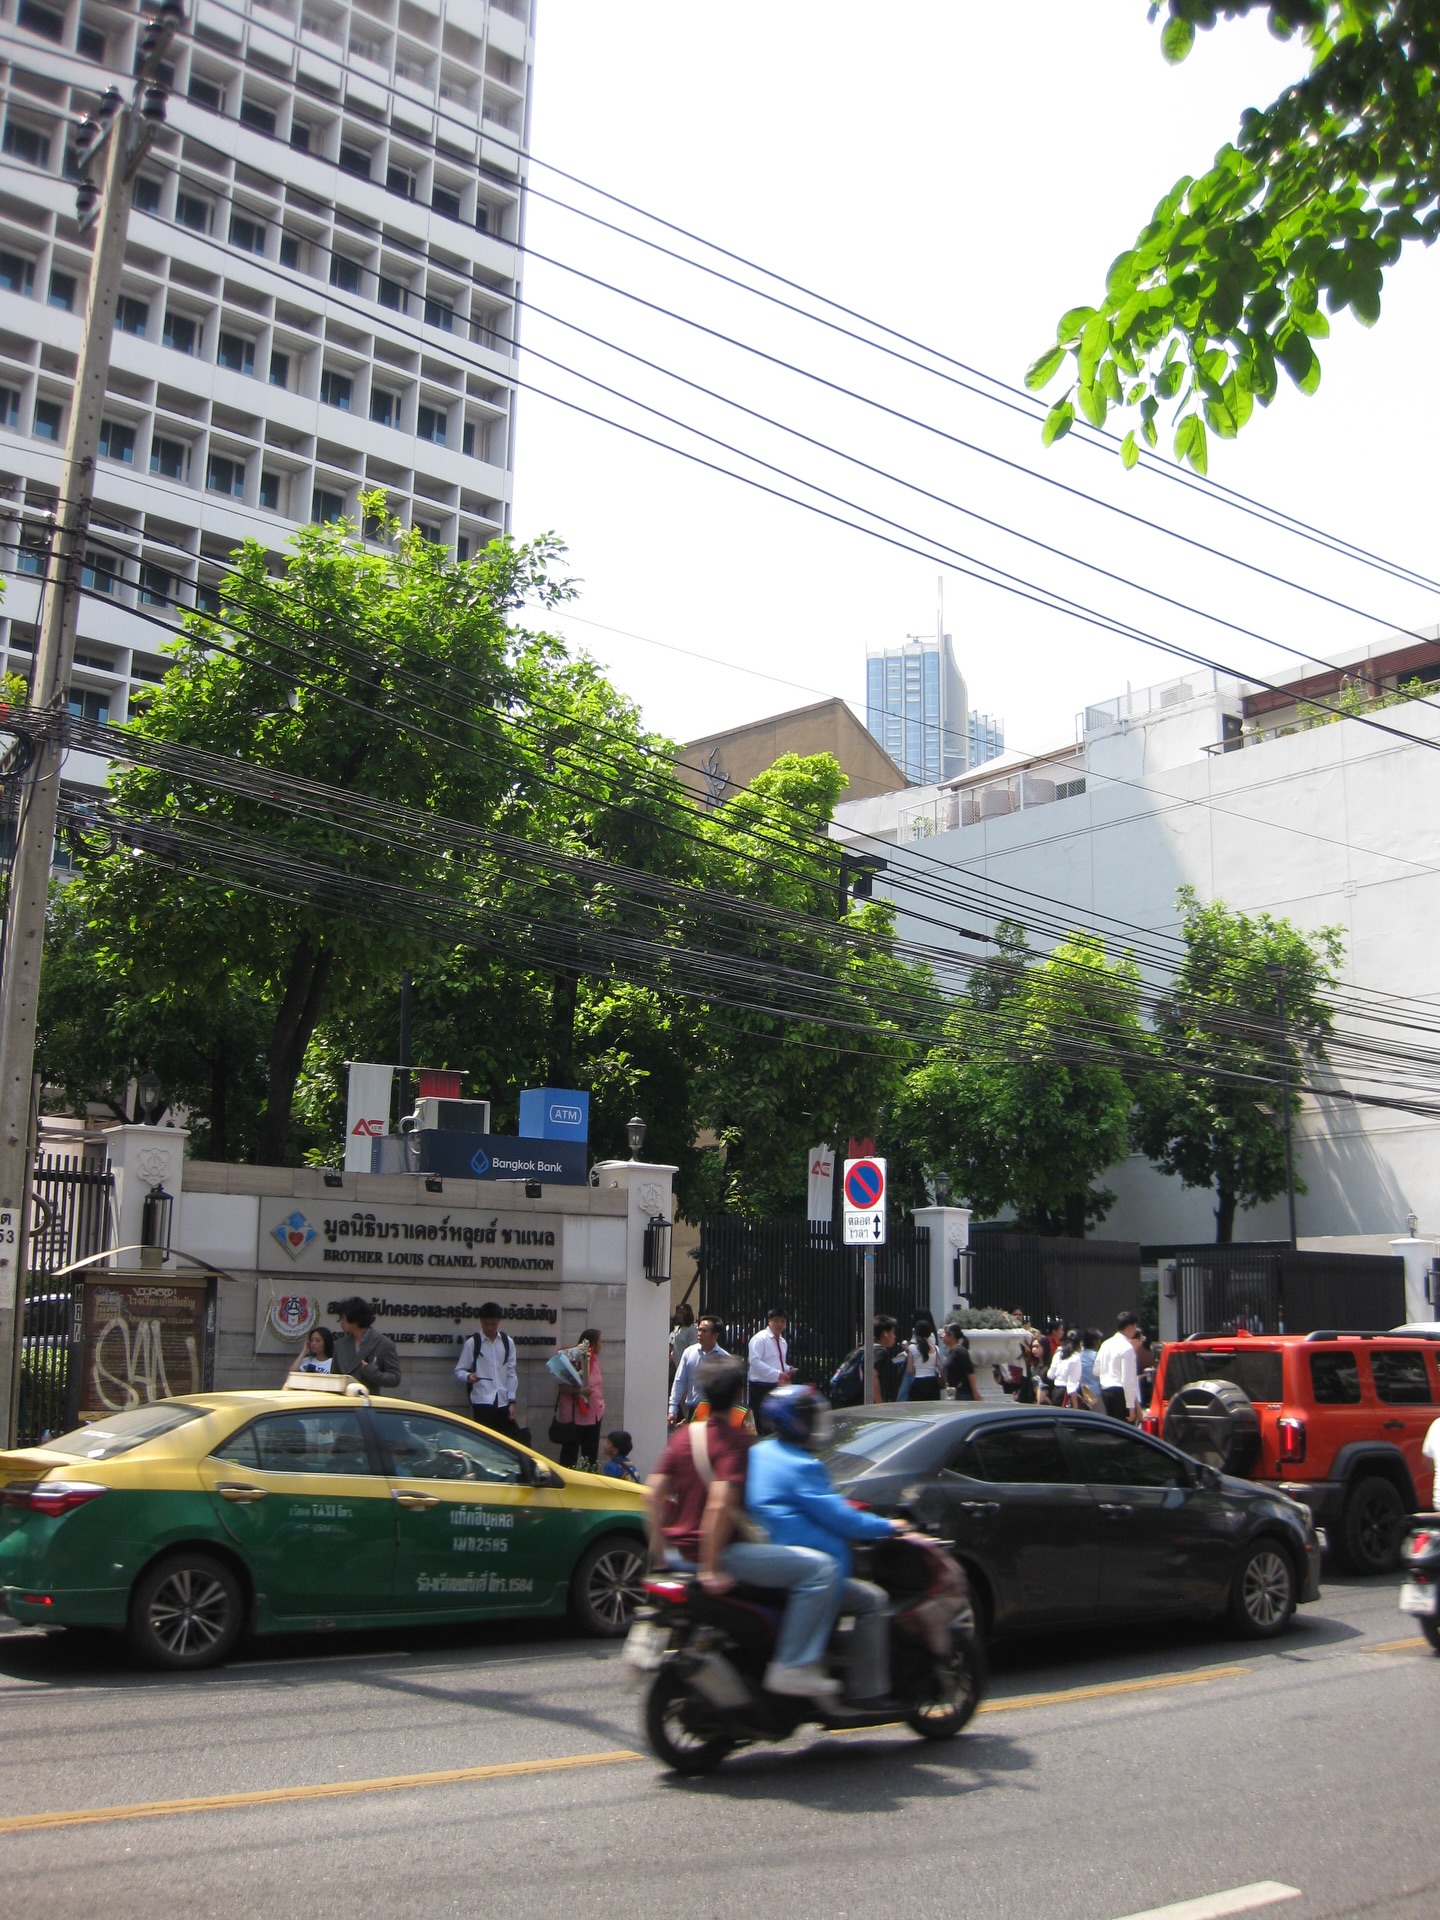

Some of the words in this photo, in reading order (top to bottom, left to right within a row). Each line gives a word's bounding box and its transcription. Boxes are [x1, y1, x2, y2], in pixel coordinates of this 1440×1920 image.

[554, 1109, 577, 1120] ATM
[492, 1157, 535, 1172] Bangkok
[537, 1160, 562, 1173] Bank
[848, 1216, 871, 1226] ตลอด
[501, 1228, 555, 1246] ชาแนล
[850, 1228, 869, 1239] เวลา
[323, 1249, 383, 1264] BROTHER
[387, 1252, 424, 1266] LOUIS
[428, 1254, 477, 1268] CHANEL
[480, 1256, 555, 1271] FOUNDATION
[418, 1333, 453, 1344] PARENTS
